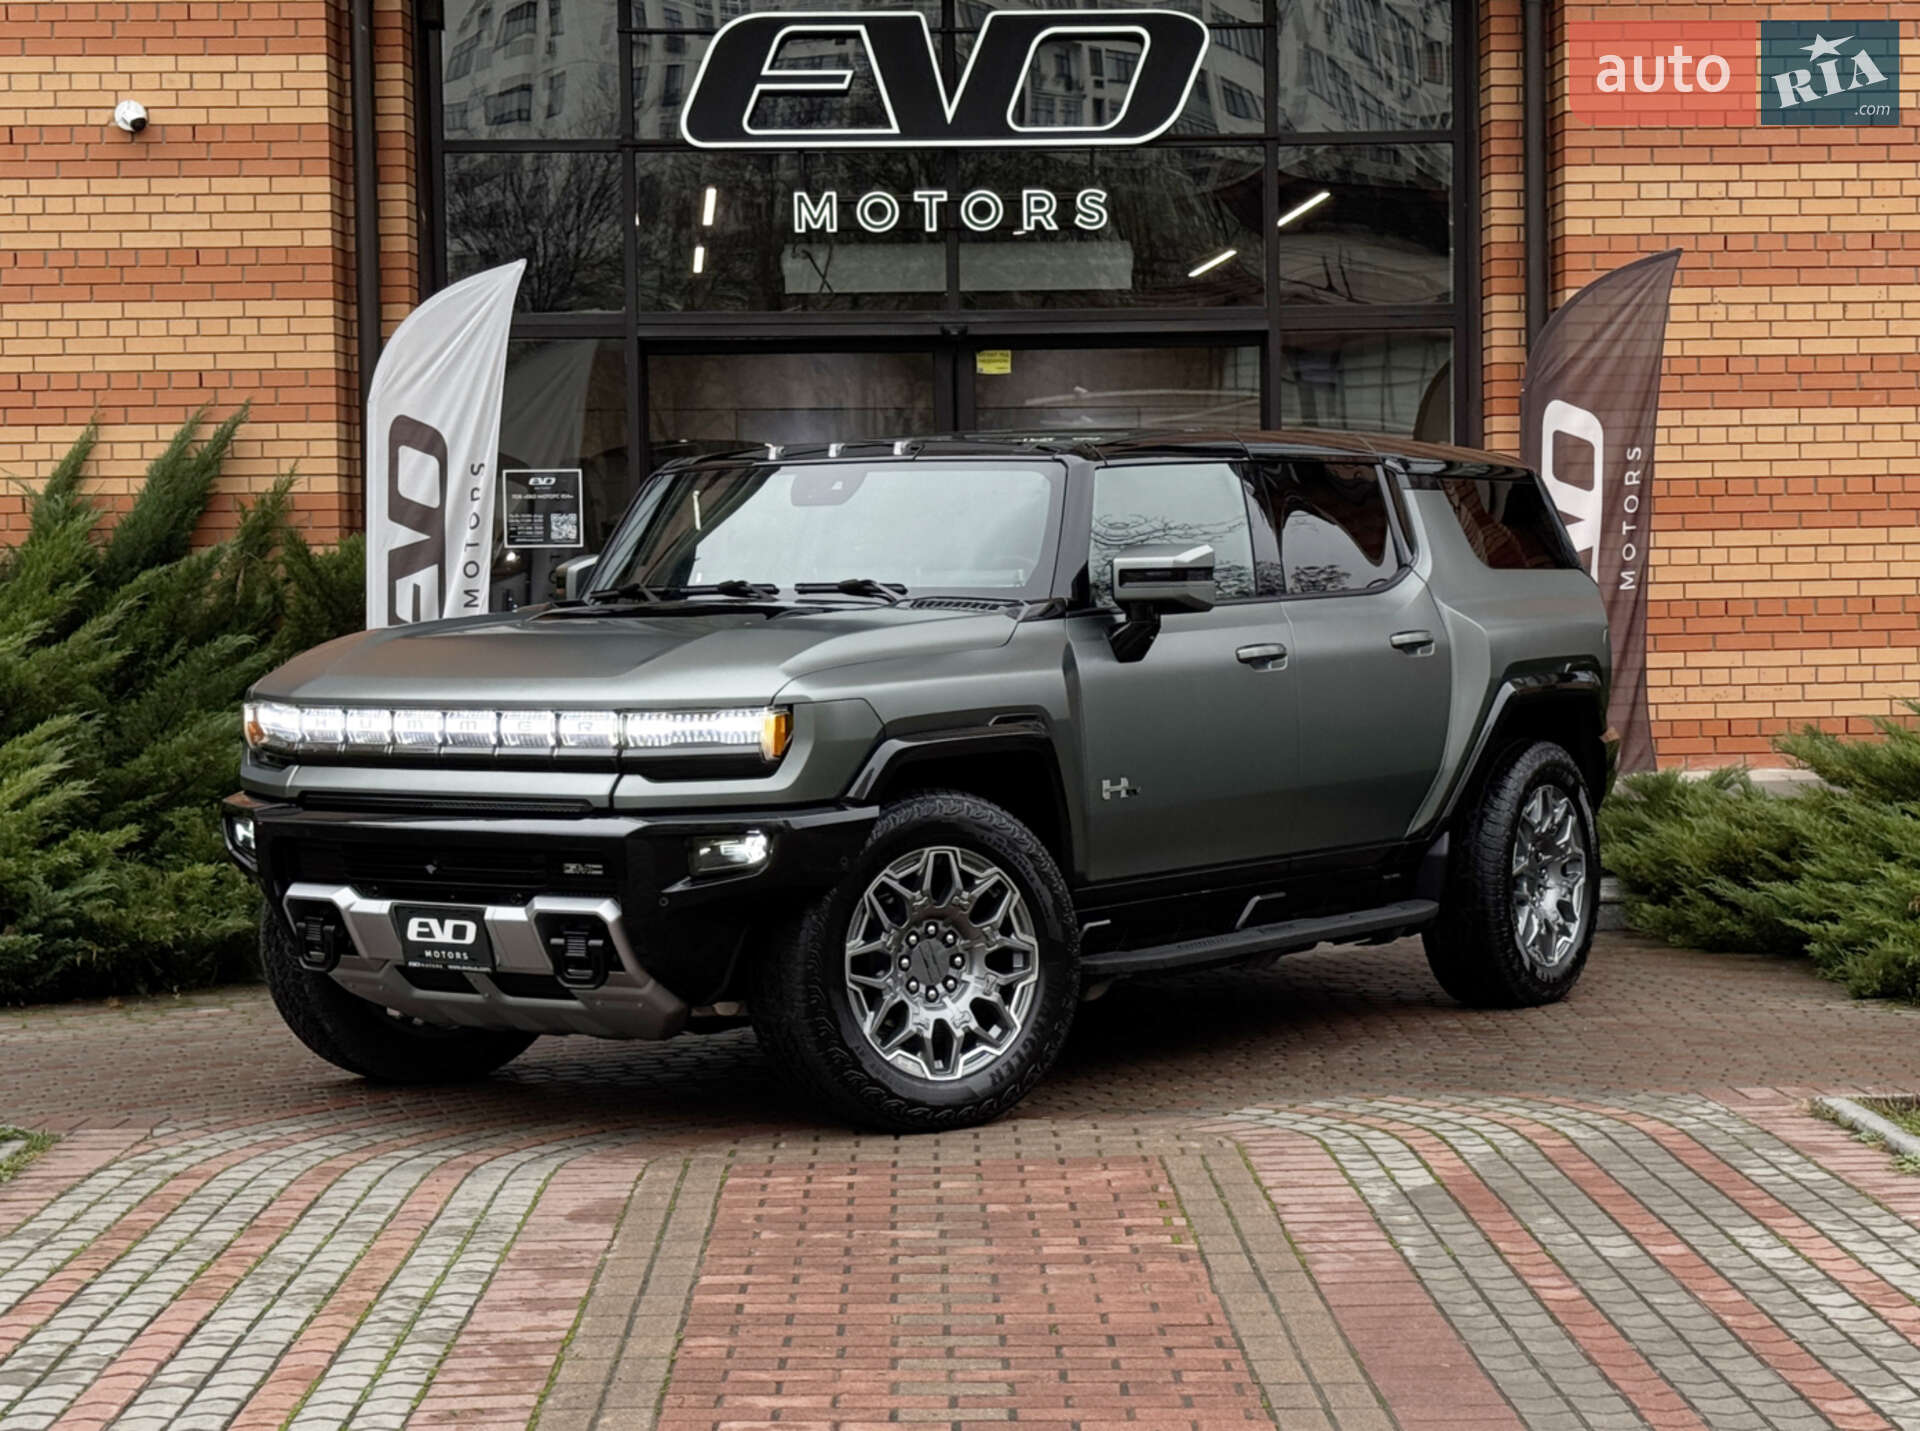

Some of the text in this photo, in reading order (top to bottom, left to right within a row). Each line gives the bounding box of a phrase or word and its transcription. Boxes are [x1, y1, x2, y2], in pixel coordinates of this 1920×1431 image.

[680, 9, 1210, 148] EVO
[794, 189, 1108, 233] MOTORS
[1541, 399, 1604, 585] VO
[1619, 447, 1642, 591] MOTORS
[407, 917, 476, 944] EVO
[424, 950, 468, 960] MOTORS
